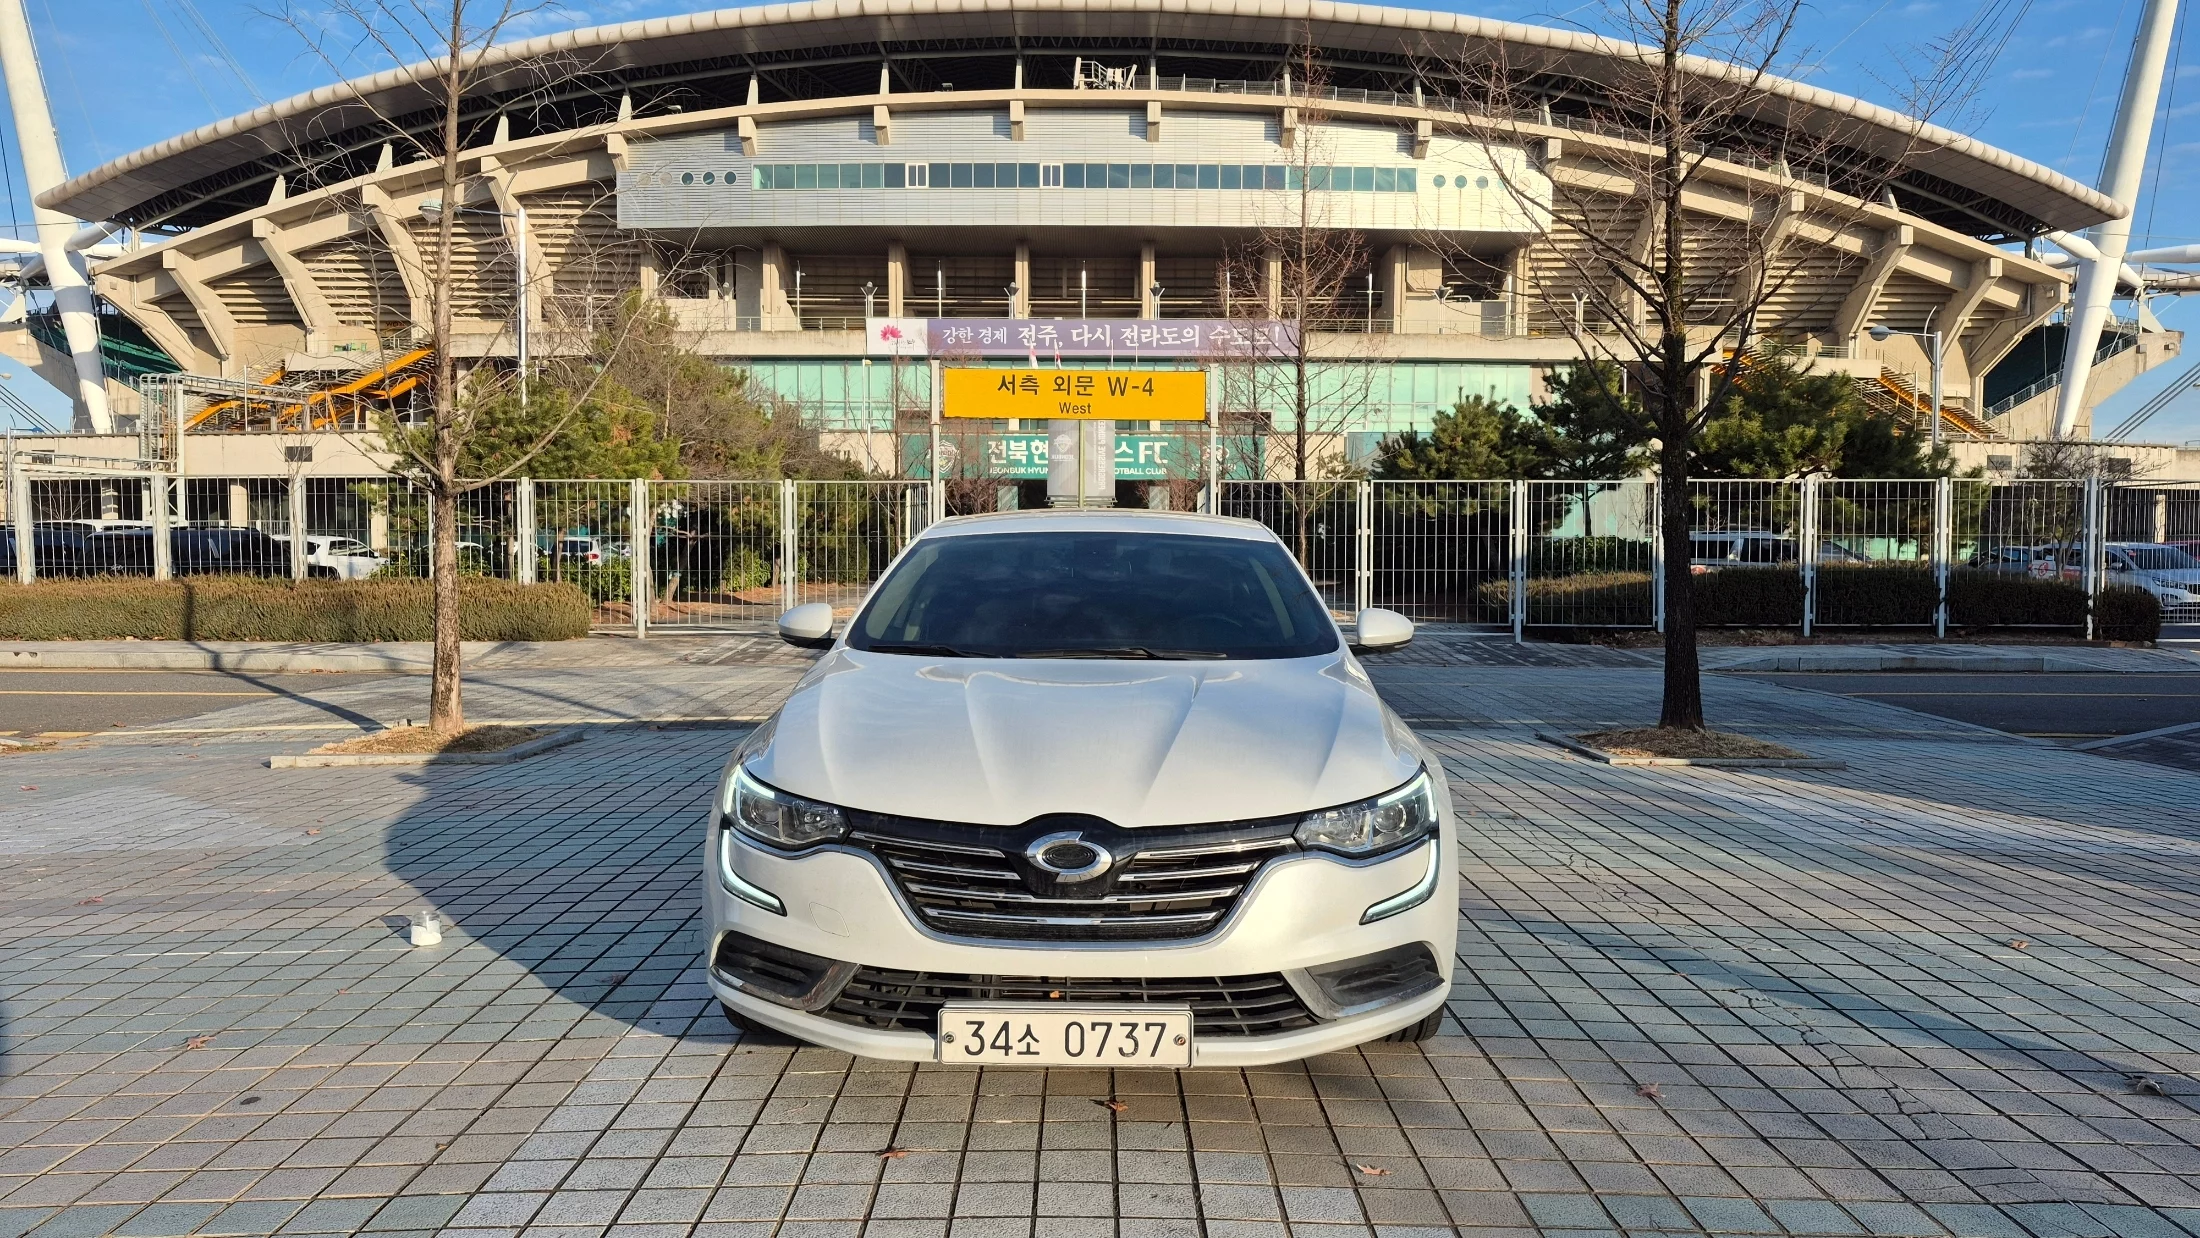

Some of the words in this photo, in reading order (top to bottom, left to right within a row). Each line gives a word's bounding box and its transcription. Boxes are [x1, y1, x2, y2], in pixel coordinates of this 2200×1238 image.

[943, 326, 974, 345] 강한
[978, 326, 1007, 345] 경제
[1018, 324, 1063, 348] 전주,
[1070, 324, 1111, 348] 다시
[1119, 324, 1200, 348] 전라도의
[997, 374, 1040, 396] 서측
[1052, 374, 1095, 397] 외문
[1107, 376, 1154, 397] W-4
[1058, 402, 1092, 415] West
[1145, 467, 1168, 475] CLUB
[964, 1020, 1040, 1057] 34소
[1064, 1021, 1168, 1058] 0737
